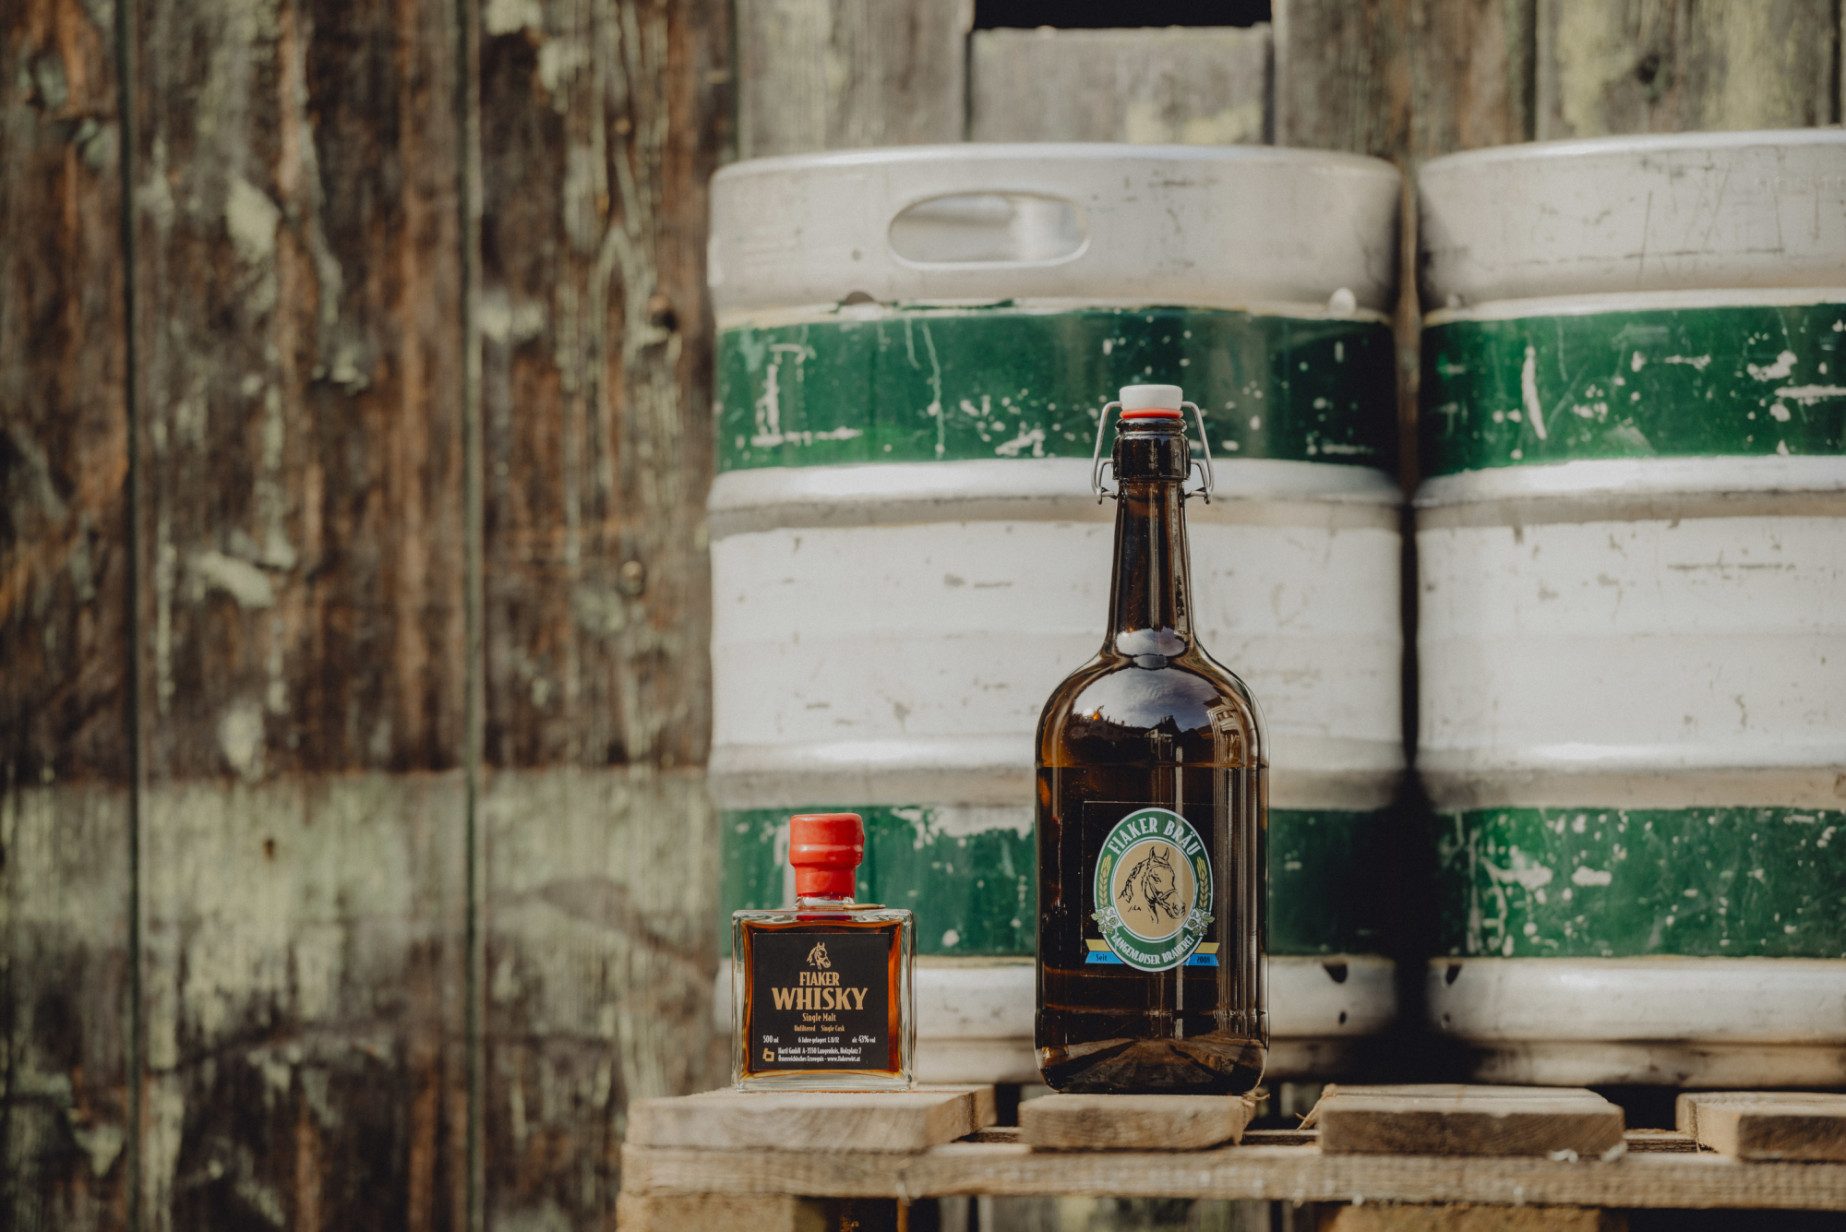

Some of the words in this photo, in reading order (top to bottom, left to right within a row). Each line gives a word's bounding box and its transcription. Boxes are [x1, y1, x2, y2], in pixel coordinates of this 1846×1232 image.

[1107, 817, 1158, 855] FIAKER
[1163, 820, 1201, 855] BRÄU
[1111, 932, 1160, 964] LANGENLOISER
[1162, 934, 1195, 963] BRAUEREI
[800, 972, 840, 986] FIAKER
[771, 987, 868, 1011] WHISKY
[802, 1012, 821, 1023] Single
[822, 1012, 837, 1021] Malt
[821, 1024, 834, 1032] Single
[835, 1024, 845, 1032] Cask
[763, 1034, 773, 1043] 500
